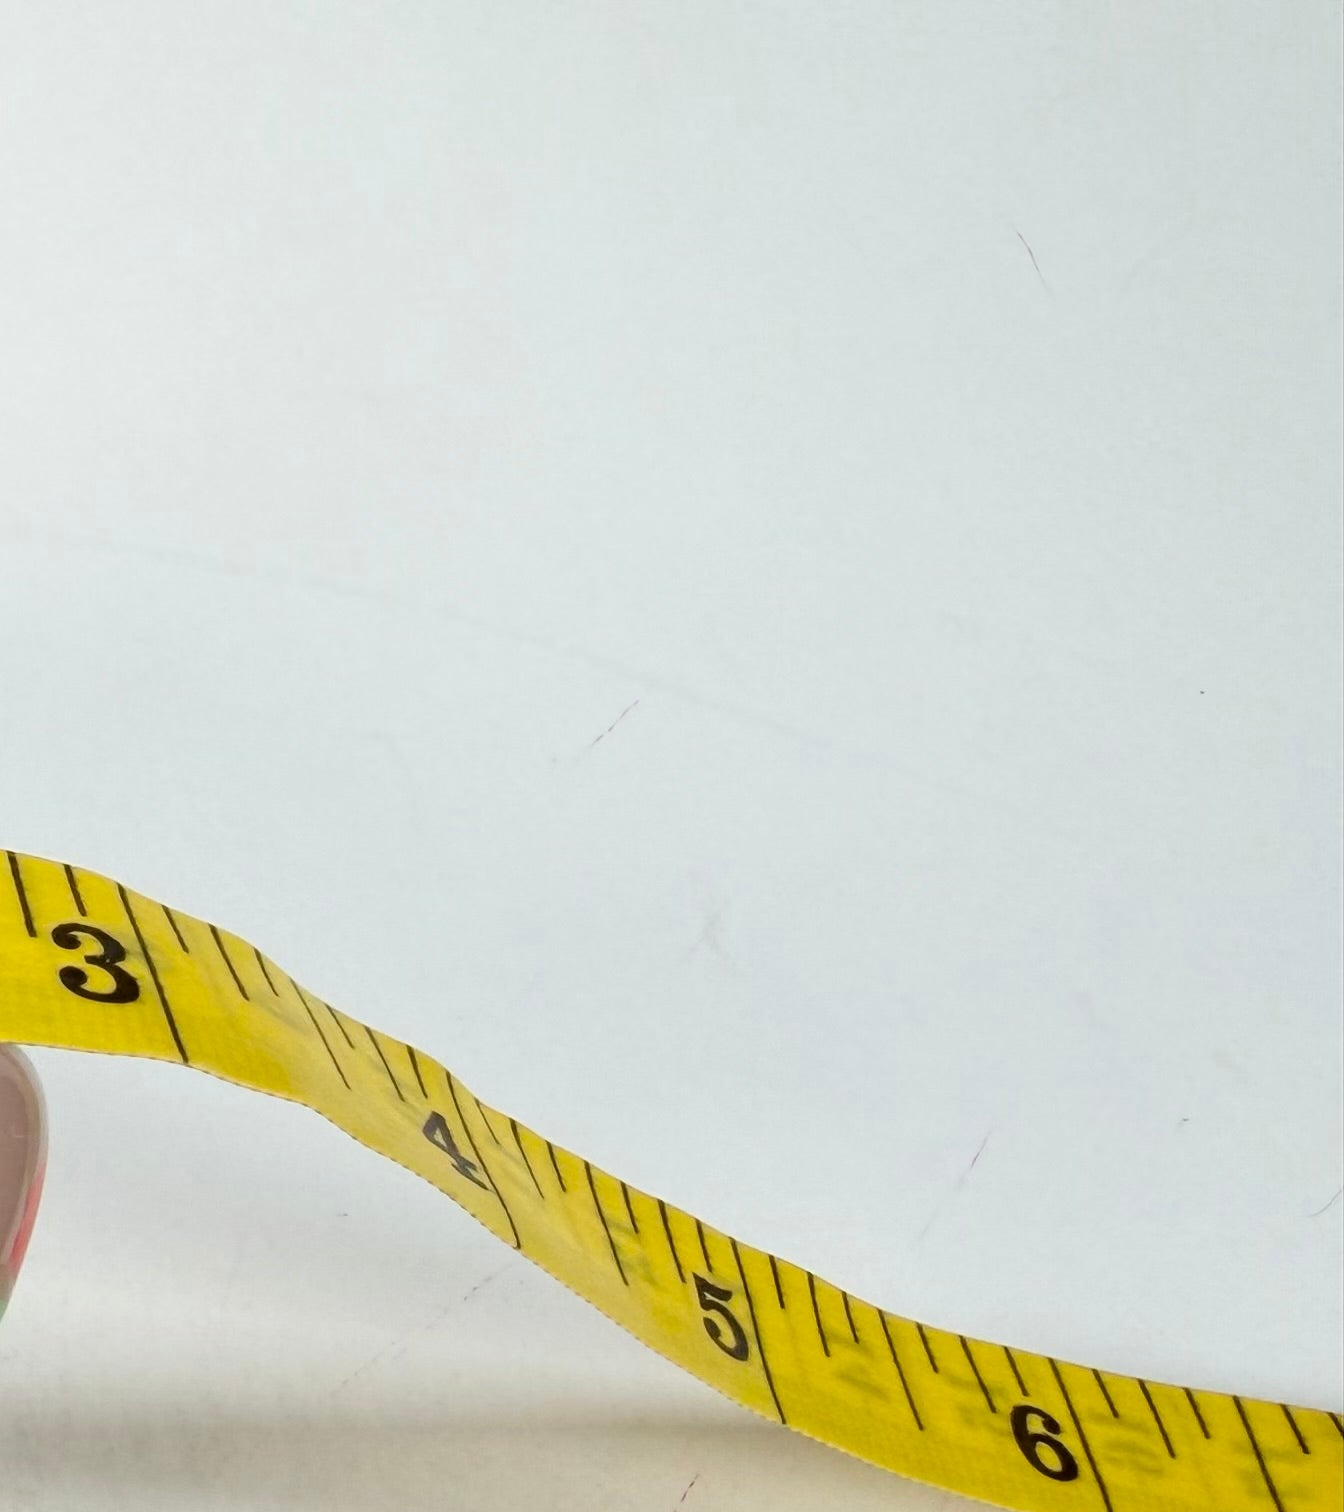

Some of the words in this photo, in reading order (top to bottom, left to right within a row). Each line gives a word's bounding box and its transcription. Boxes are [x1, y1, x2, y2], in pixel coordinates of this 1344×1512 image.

[51, 922, 141, 1004] 3
[422, 1111, 490, 1191] 4
[692, 1272, 750, 1362] 5
[1010, 1404, 1079, 1482] 6
